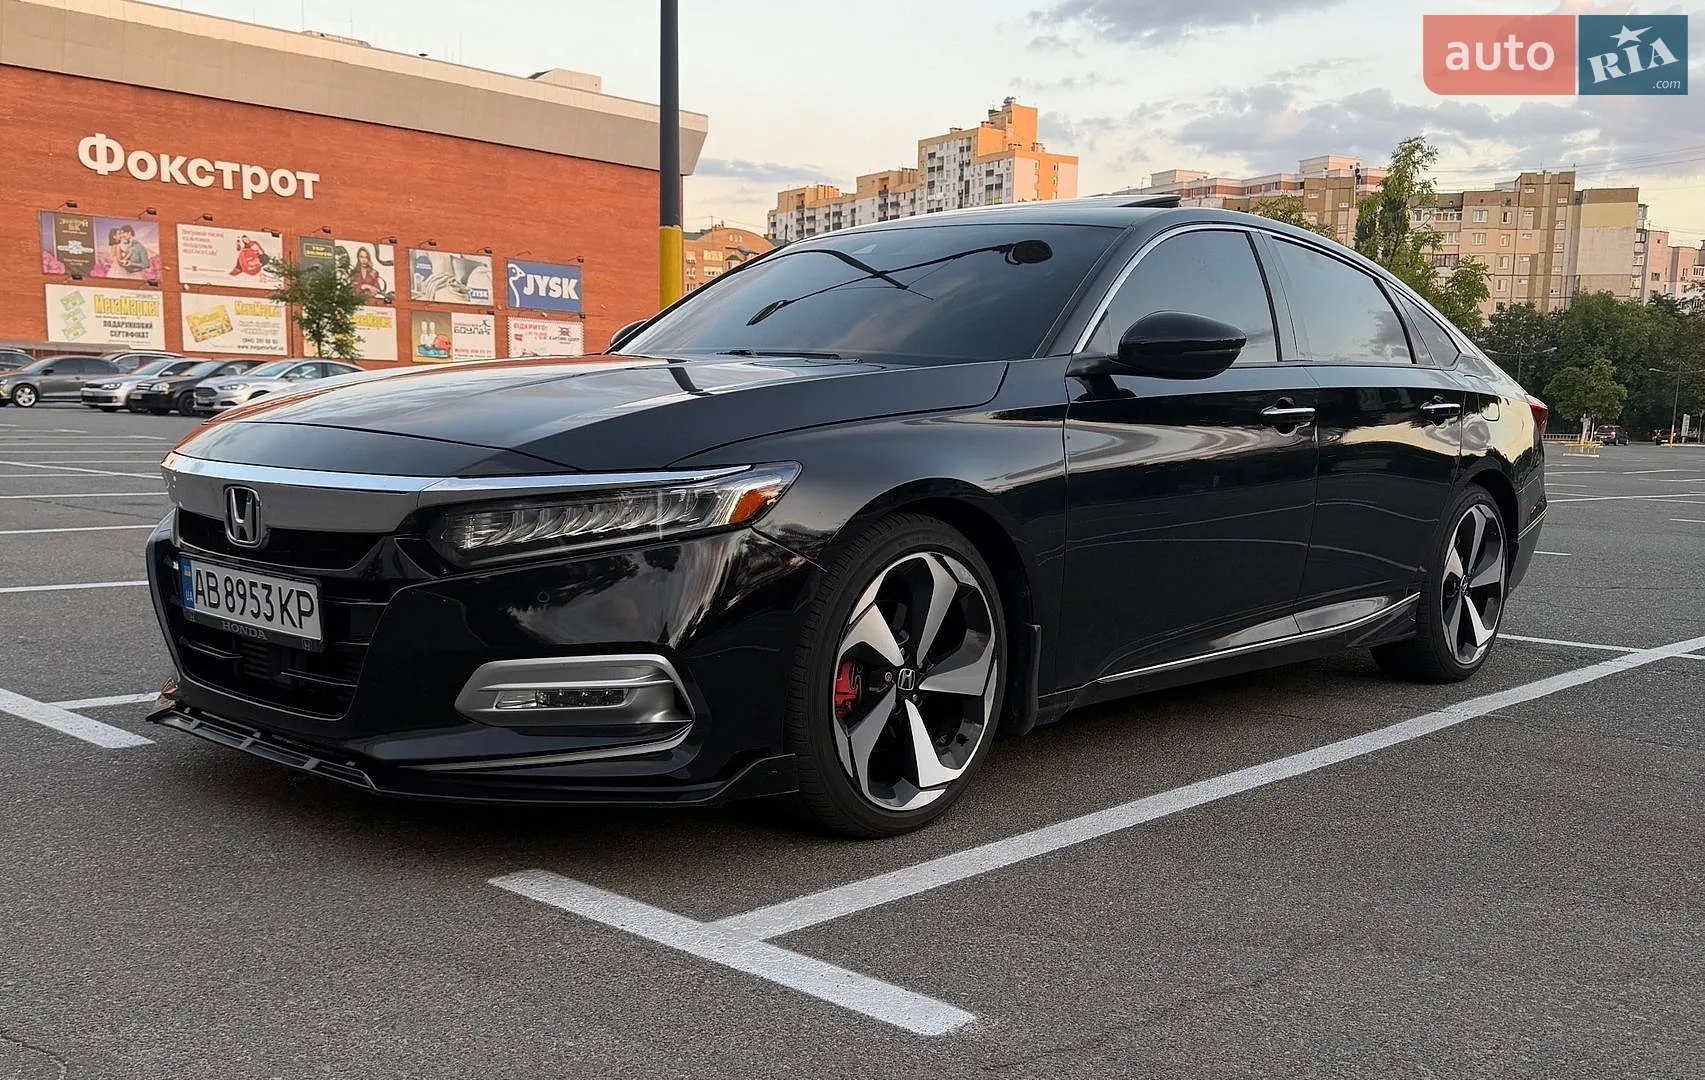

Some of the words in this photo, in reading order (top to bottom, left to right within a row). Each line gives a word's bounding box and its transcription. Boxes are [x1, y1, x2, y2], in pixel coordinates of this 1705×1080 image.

[78, 132, 321, 200] Фокстрот
[523, 273, 579, 300] JYSK
[185, 590, 194, 602] UA
[221, 620, 269, 641] HONDA
